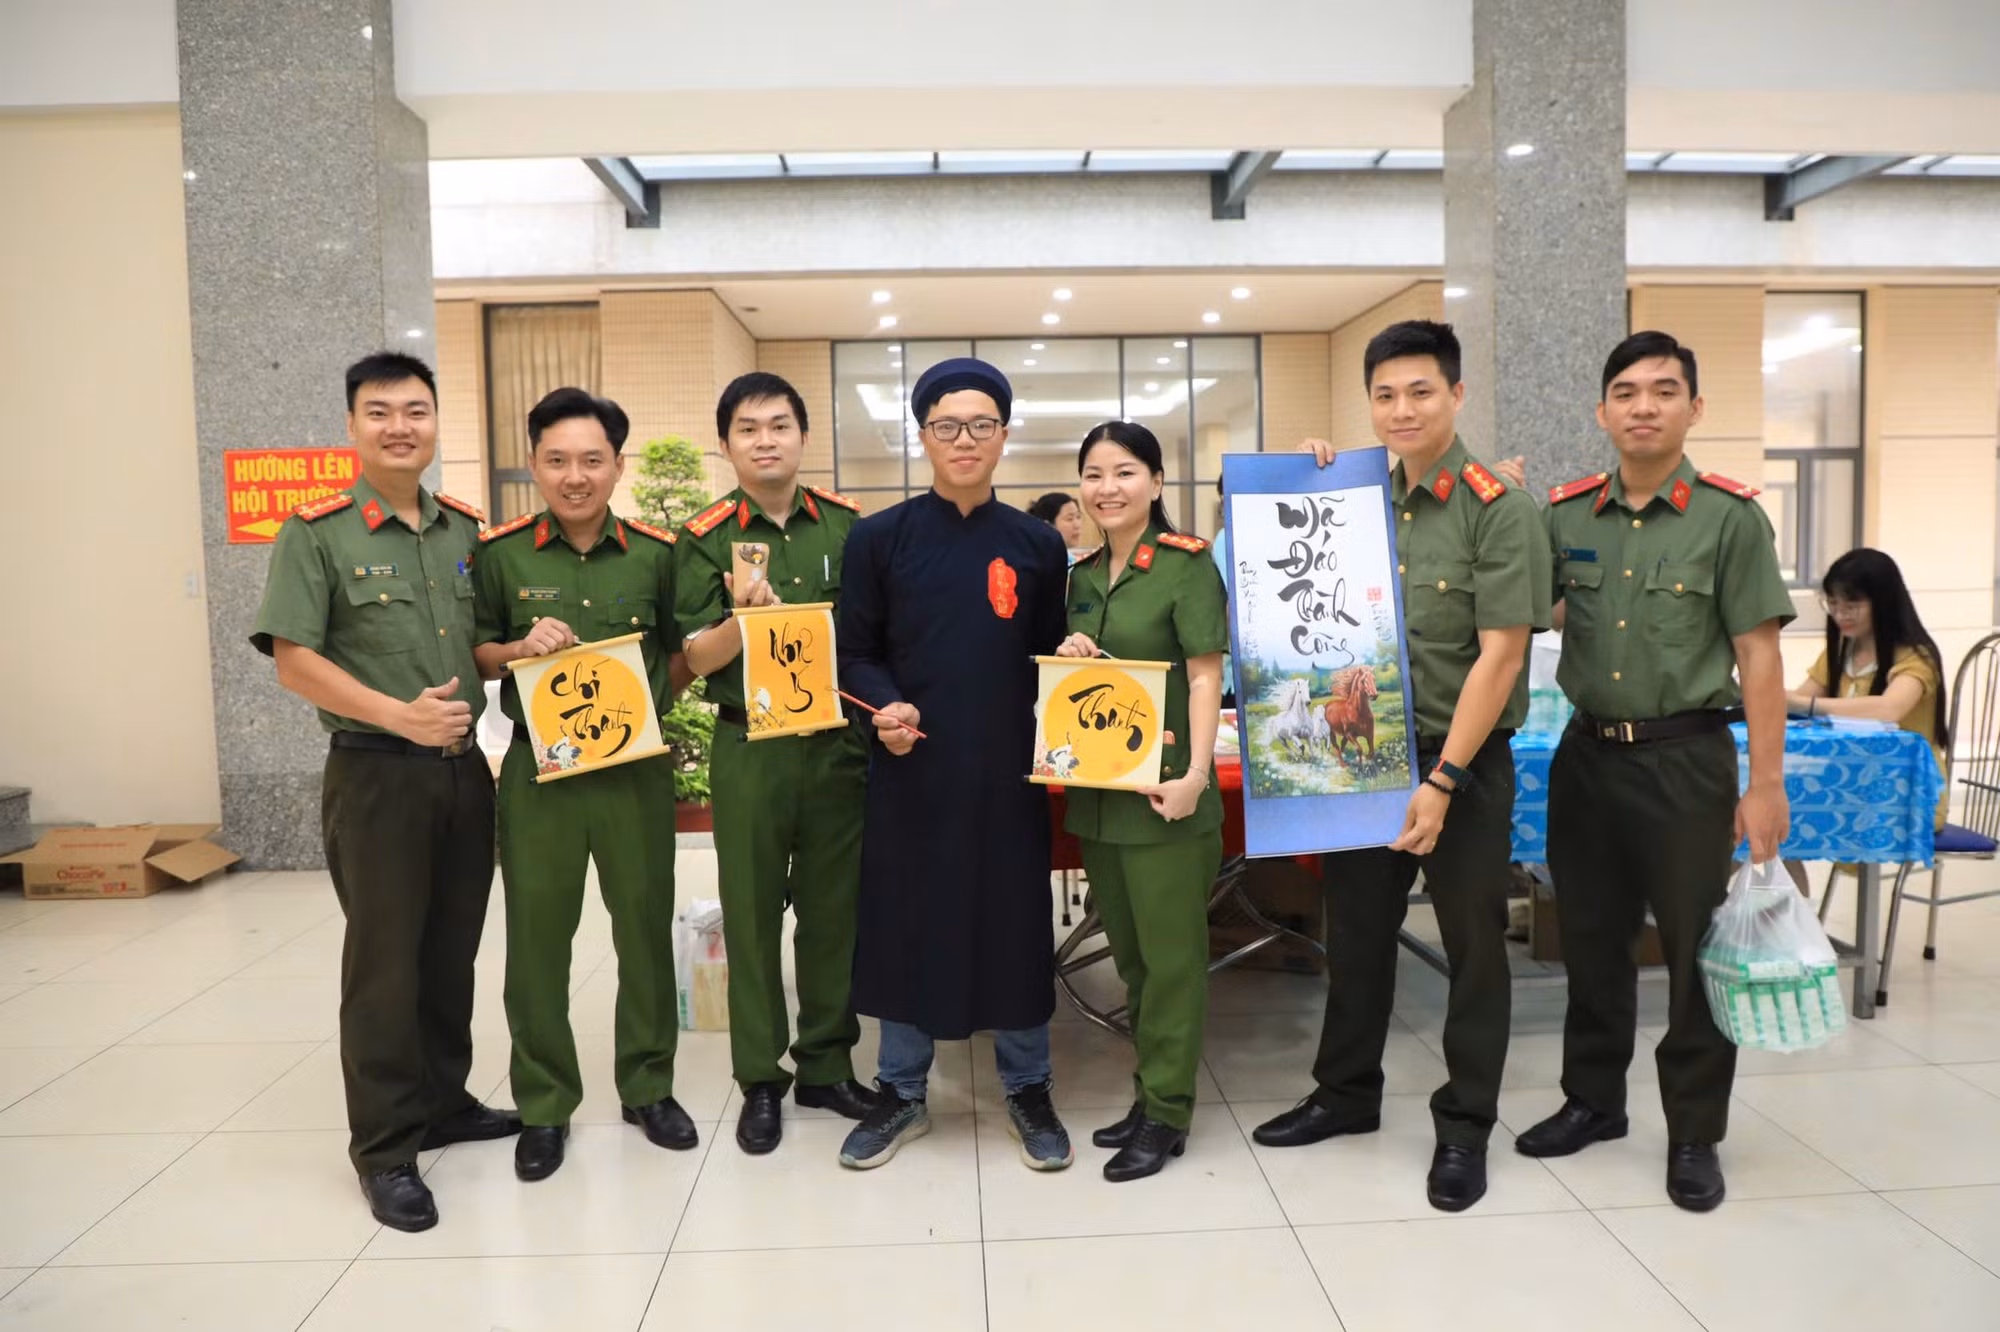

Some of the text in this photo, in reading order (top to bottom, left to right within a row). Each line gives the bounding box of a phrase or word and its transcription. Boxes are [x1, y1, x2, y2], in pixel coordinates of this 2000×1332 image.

[234, 452, 353, 482] HƯỚNG LÊN
[232, 483, 345, 518] HỘI TRƯỜ
